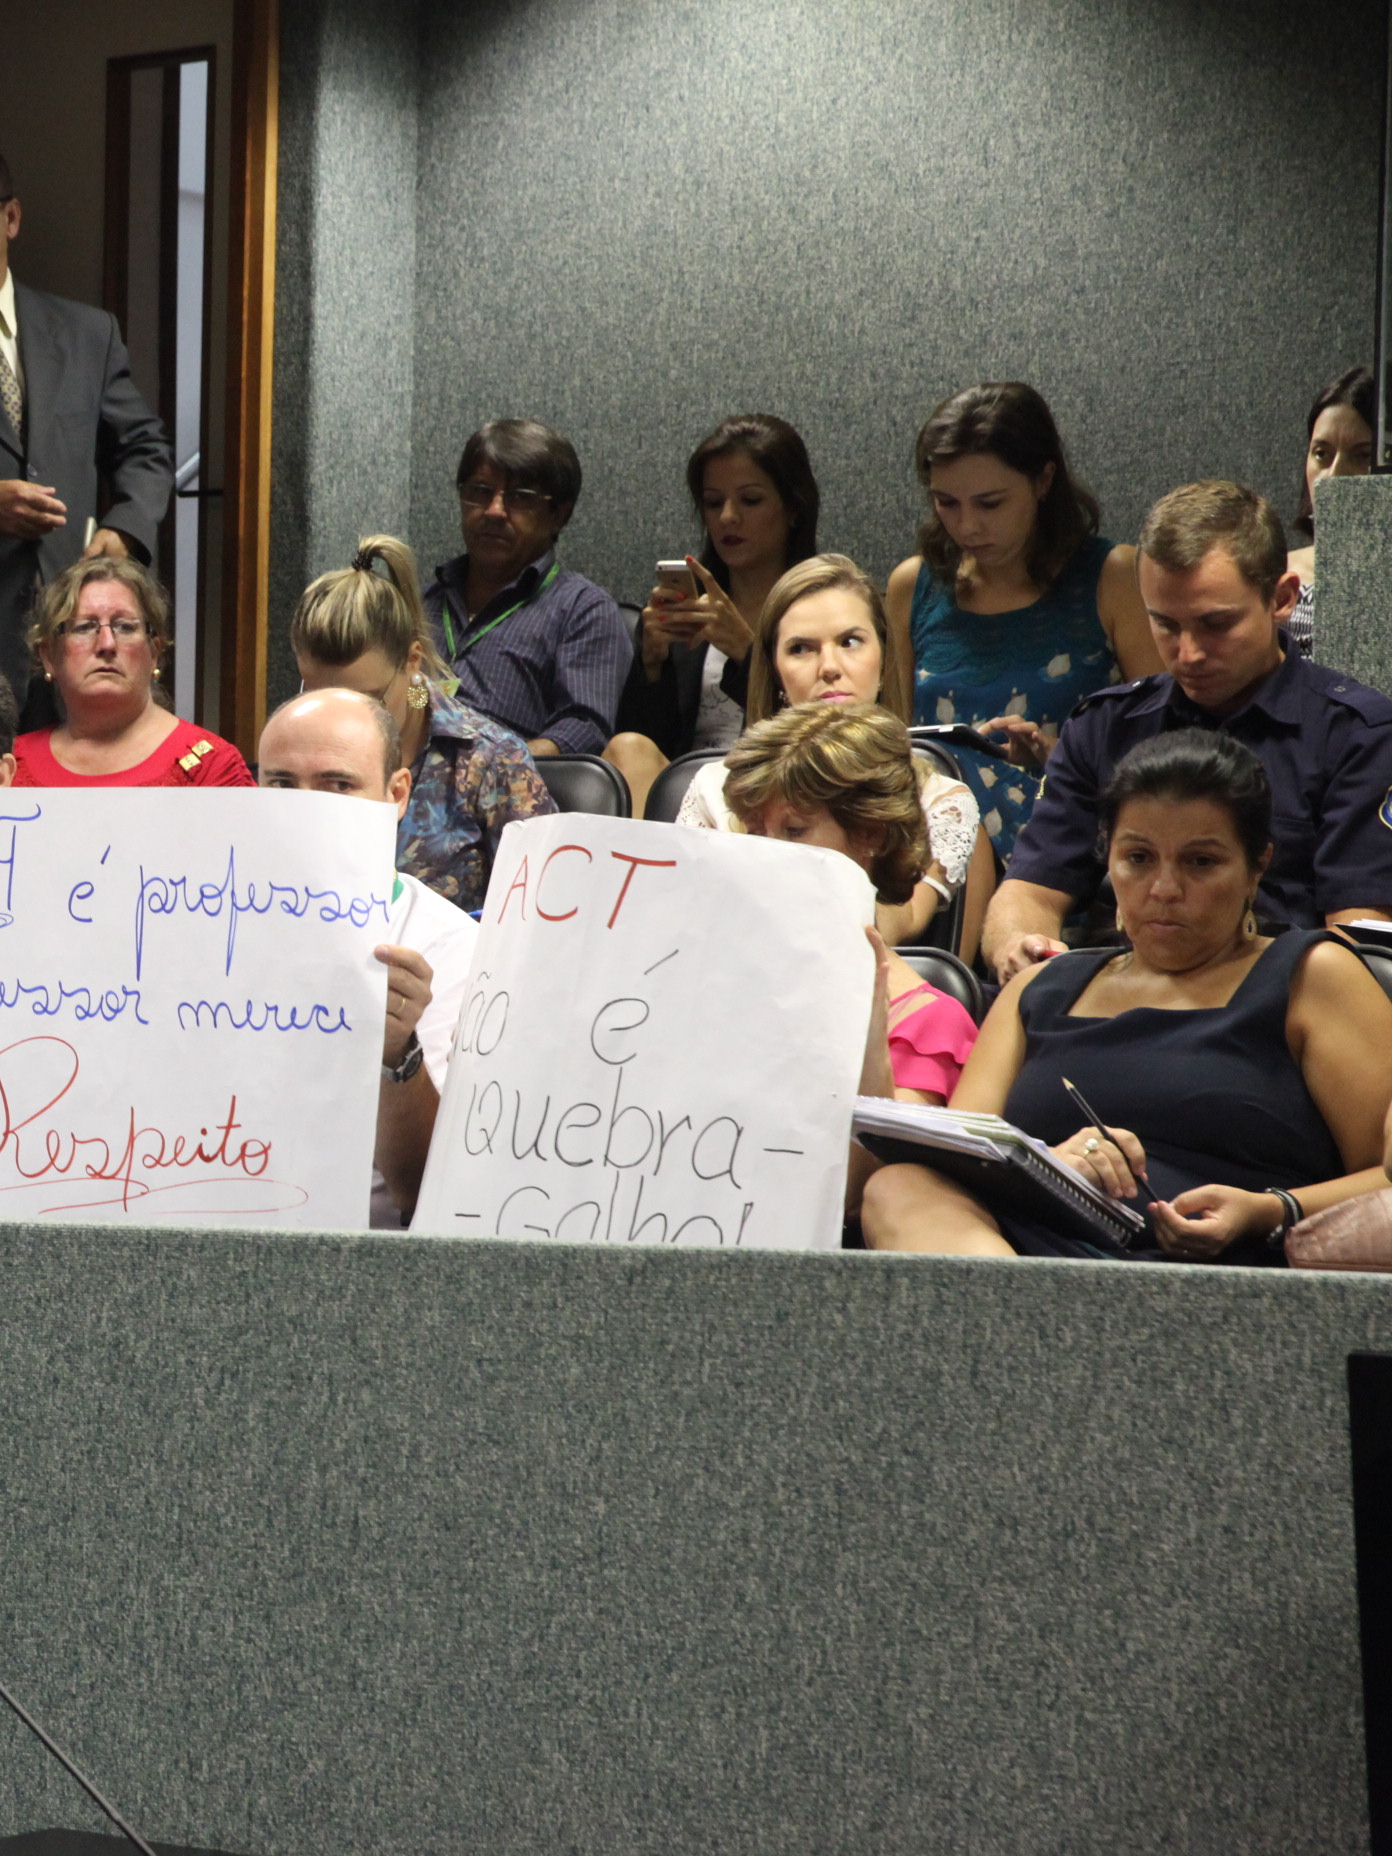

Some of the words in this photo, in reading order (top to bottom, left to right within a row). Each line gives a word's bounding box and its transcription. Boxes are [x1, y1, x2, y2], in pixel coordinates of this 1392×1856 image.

[67, 844, 111, 922] é
[135, 845, 390, 981] professor
[497, 844, 678, 931] ACT
[591, 949, 680, 1066] é
